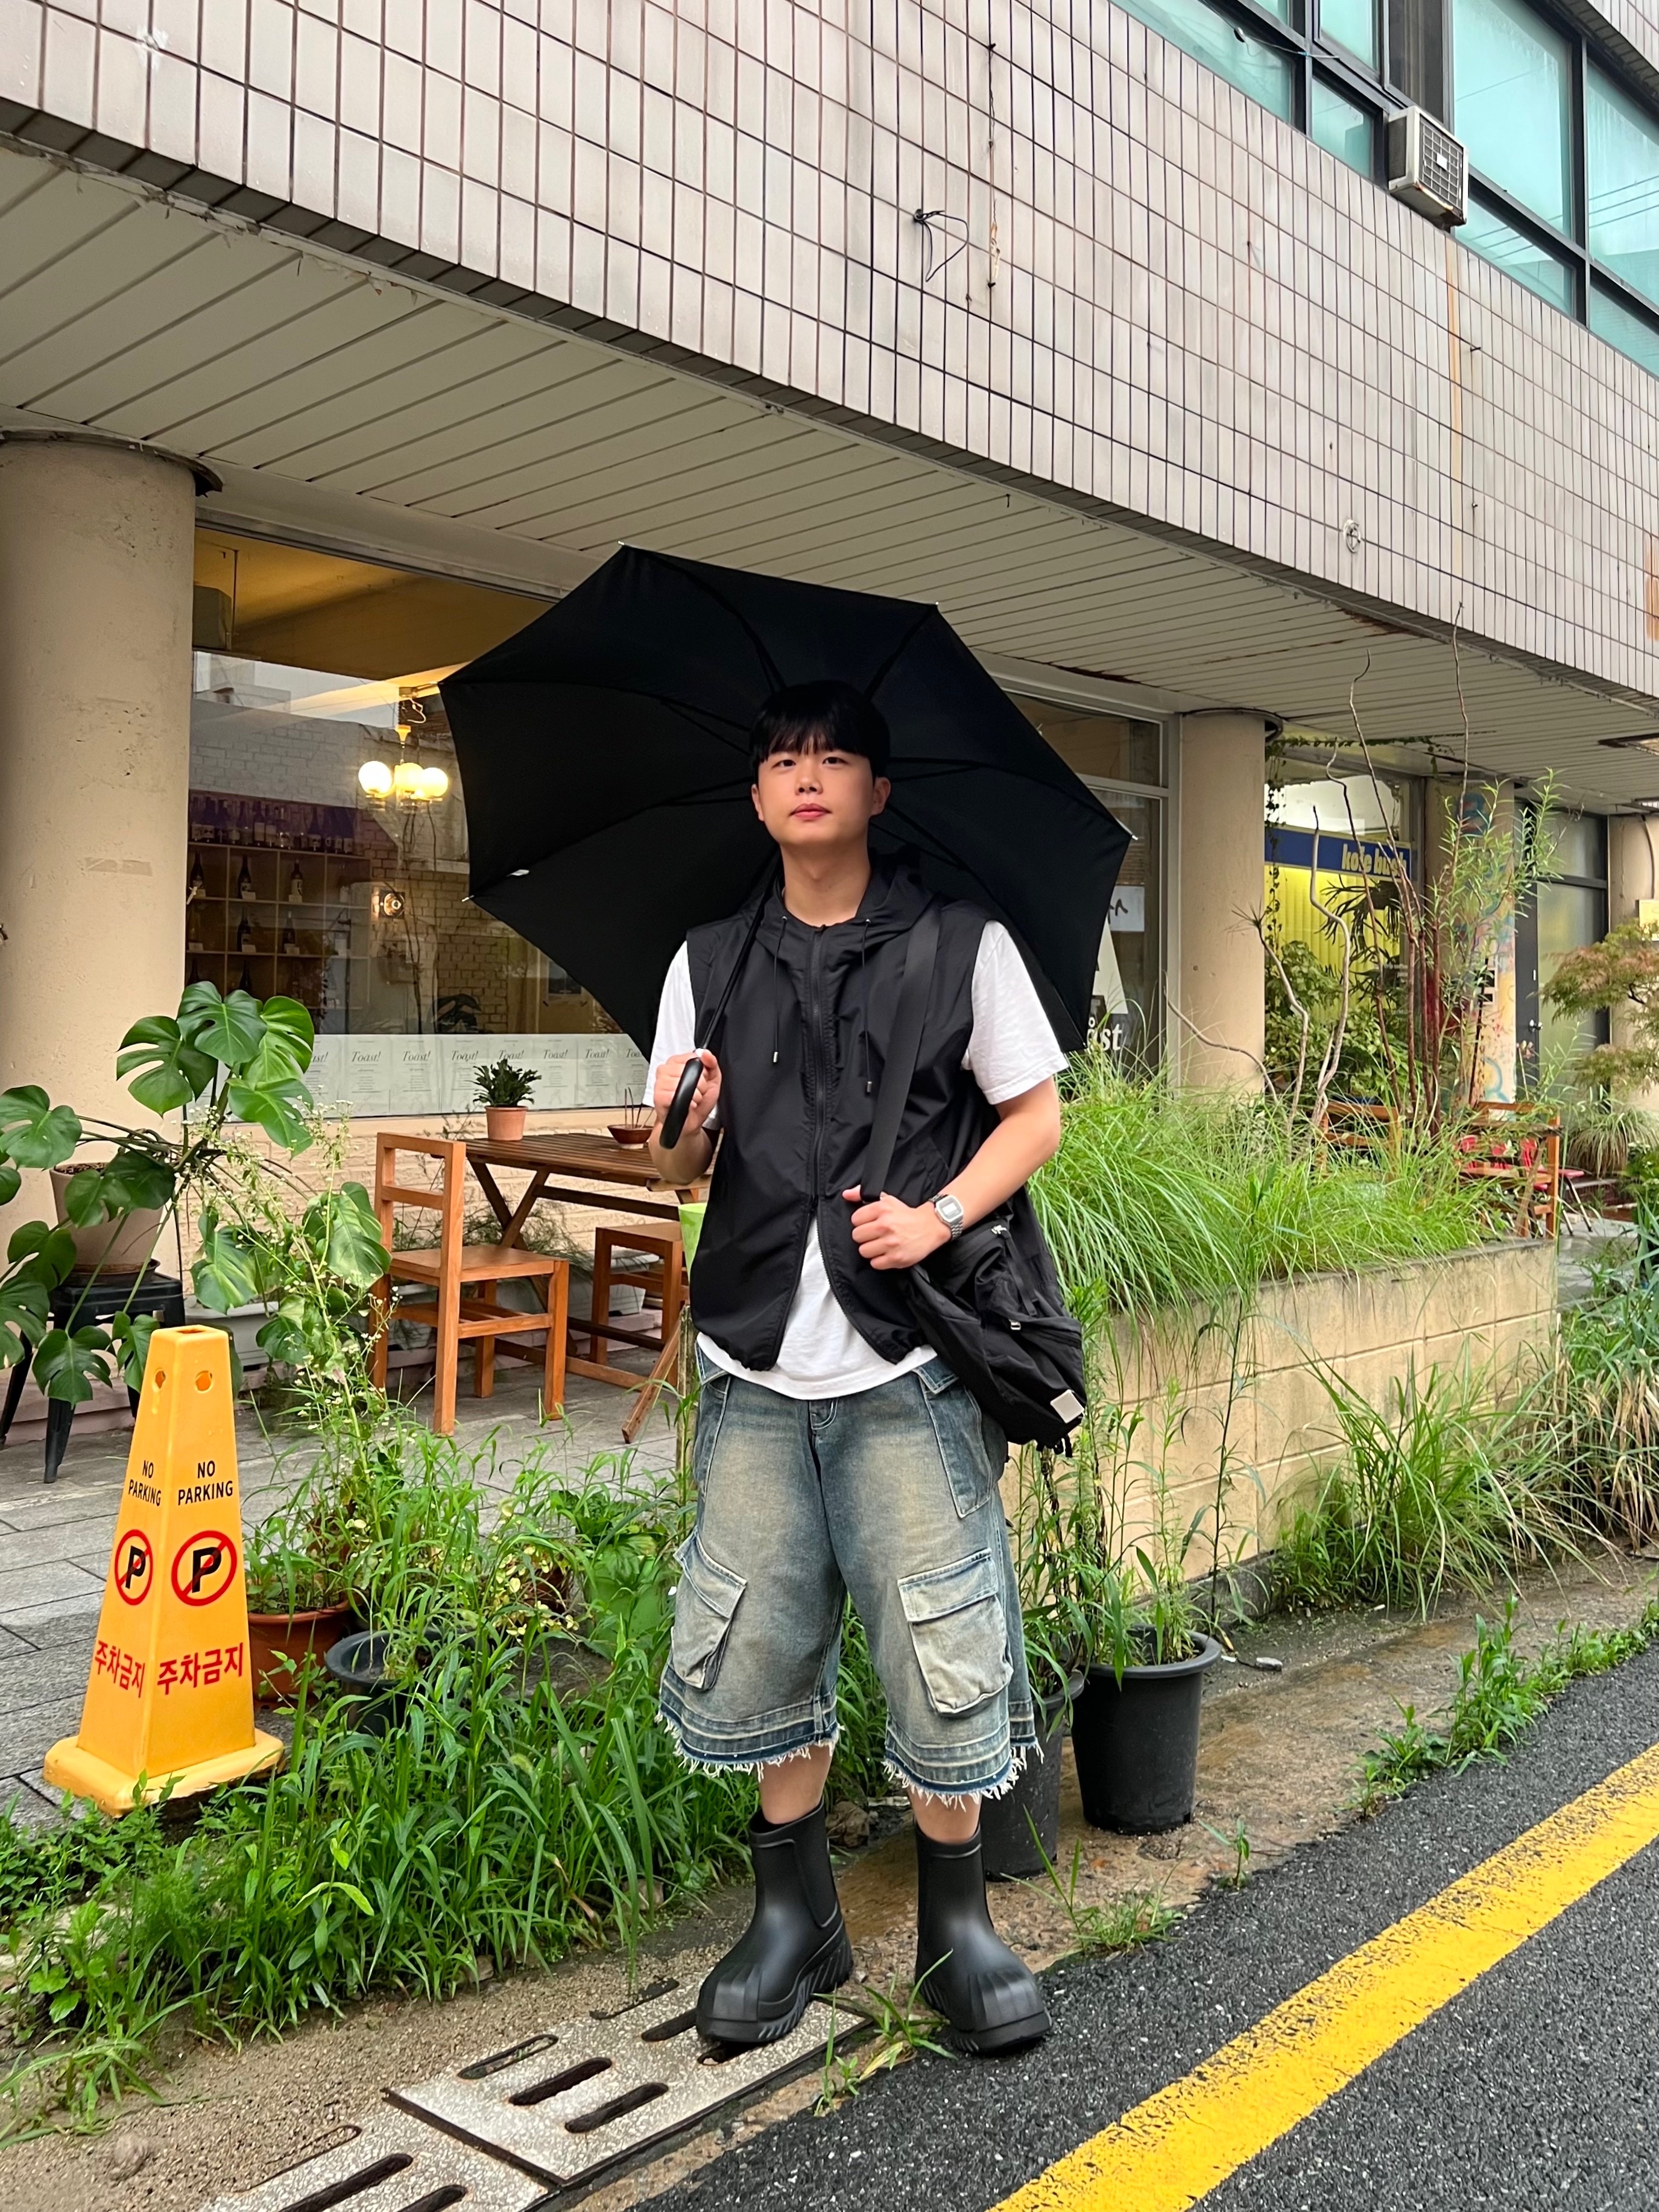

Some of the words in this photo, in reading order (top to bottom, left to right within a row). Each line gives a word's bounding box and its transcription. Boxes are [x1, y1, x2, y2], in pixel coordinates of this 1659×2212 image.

[352, 1051, 381, 1063] Toast!
[402, 1051, 431, 1062] Toast!
[451, 1050, 479, 1062] Toast!
[499, 1049, 525, 1060] Toast!
[543, 1049, 569, 1059] Toast!
[585, 1049, 610, 1059] Toast!
[626, 1048, 642, 1058] Toa
[142, 1459, 154, 1479] NO
[197, 1460, 215, 1479] NO
[128, 1479, 162, 1506] PARKING
[178, 1480, 233, 1505] PARKING
[95, 1640, 145, 1698] 주차금지
[157, 1642, 244, 1695] 주차금지
